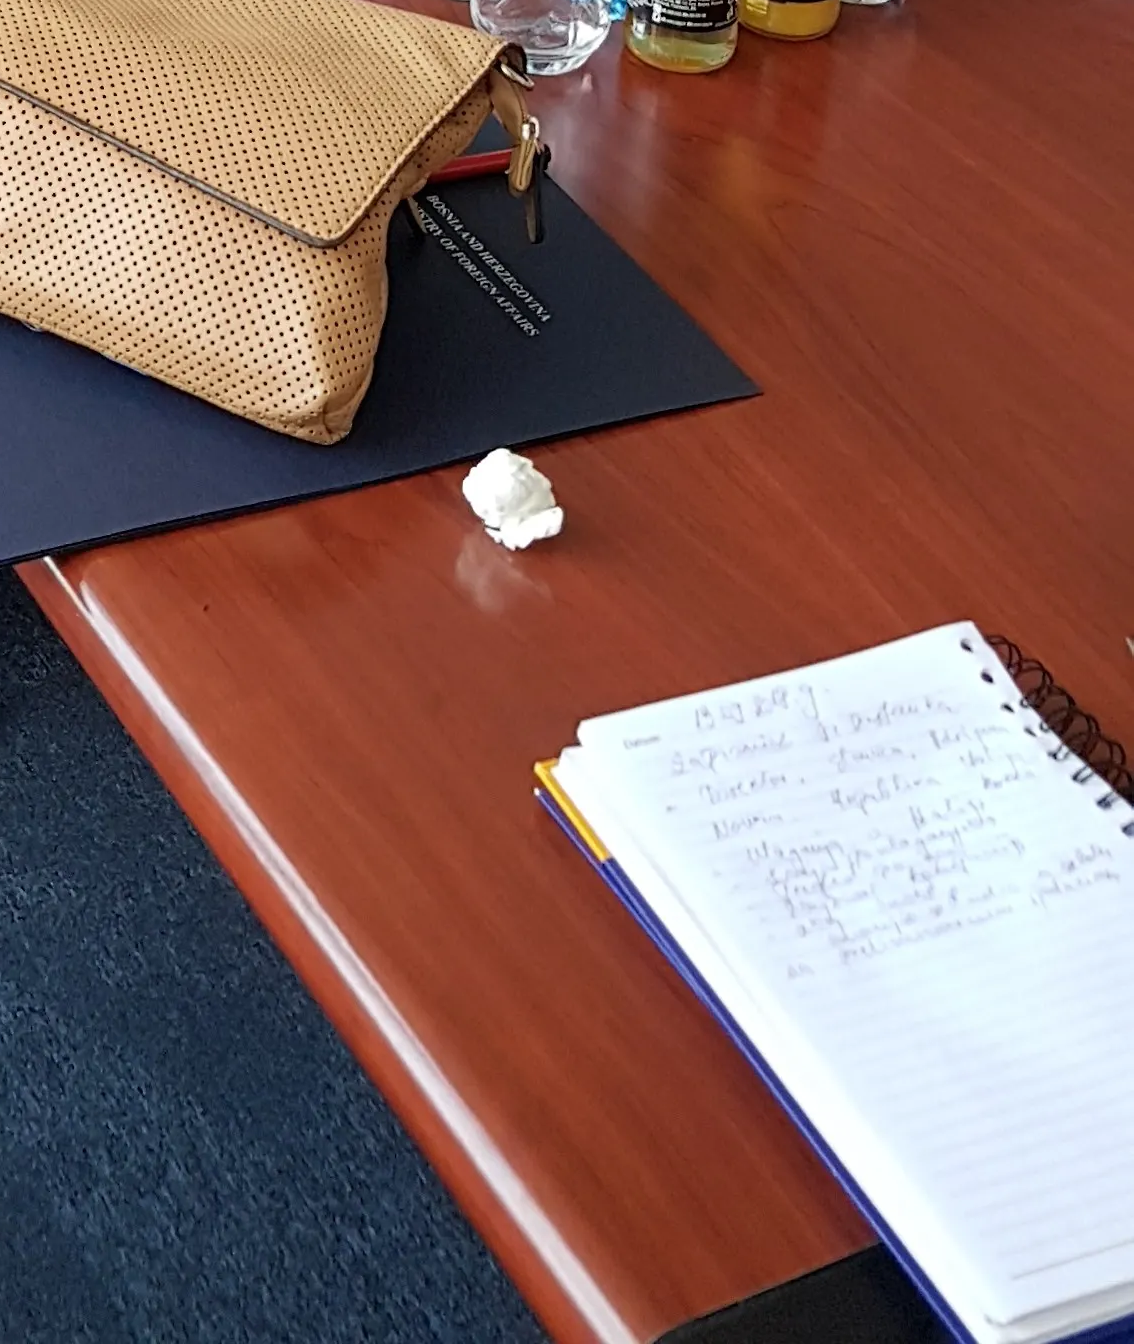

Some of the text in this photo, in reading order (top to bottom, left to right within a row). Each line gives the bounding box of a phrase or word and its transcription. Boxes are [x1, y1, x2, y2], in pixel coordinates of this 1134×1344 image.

[426, 195, 551, 322] BOSNIA AND HERZEGOVINA
[440, 237, 460, 251] OF
[451, 251, 500, 296] FOREIGN
[494, 295, 540, 337] AFFAIRS
